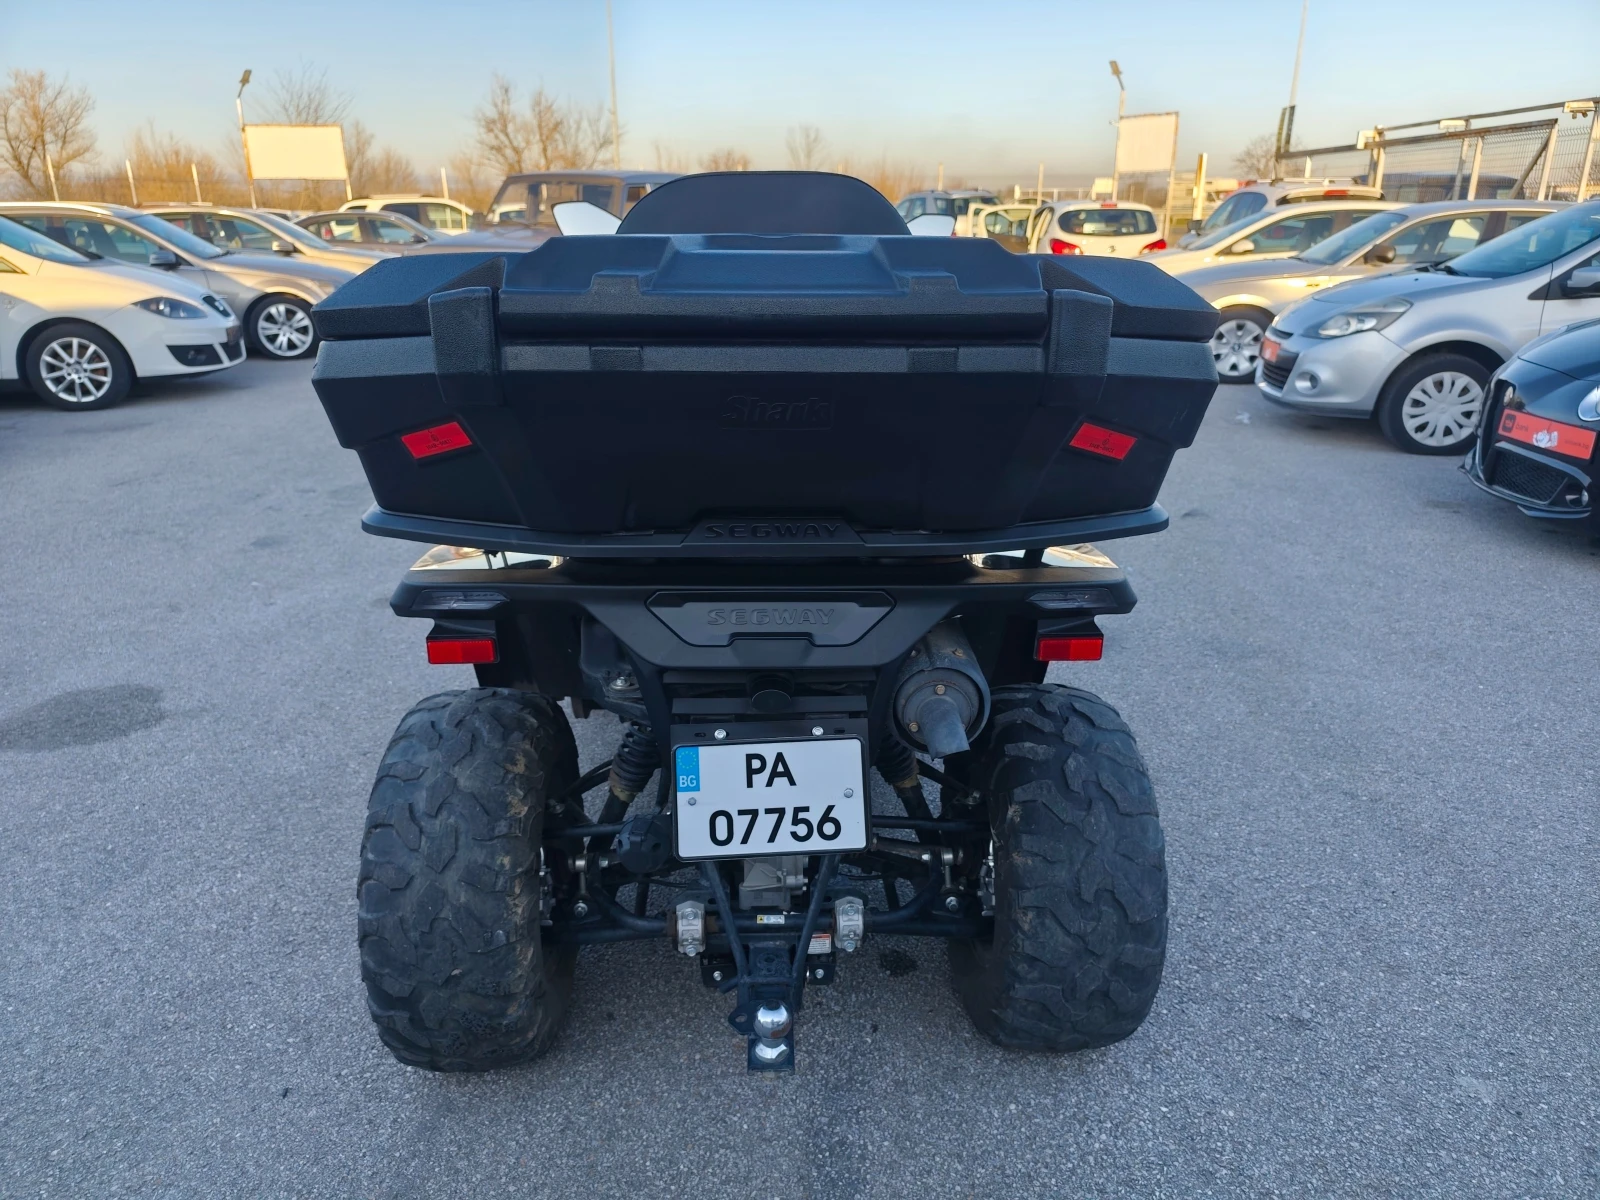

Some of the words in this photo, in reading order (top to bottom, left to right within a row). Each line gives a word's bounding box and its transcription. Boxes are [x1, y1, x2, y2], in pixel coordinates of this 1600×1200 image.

[704, 523, 841, 539] SEGWAY
[707, 608, 836, 626] SEGWAY
[745, 751, 797, 789] PA
[679, 775, 697, 788] BG
[709, 804, 842, 847] 07756
